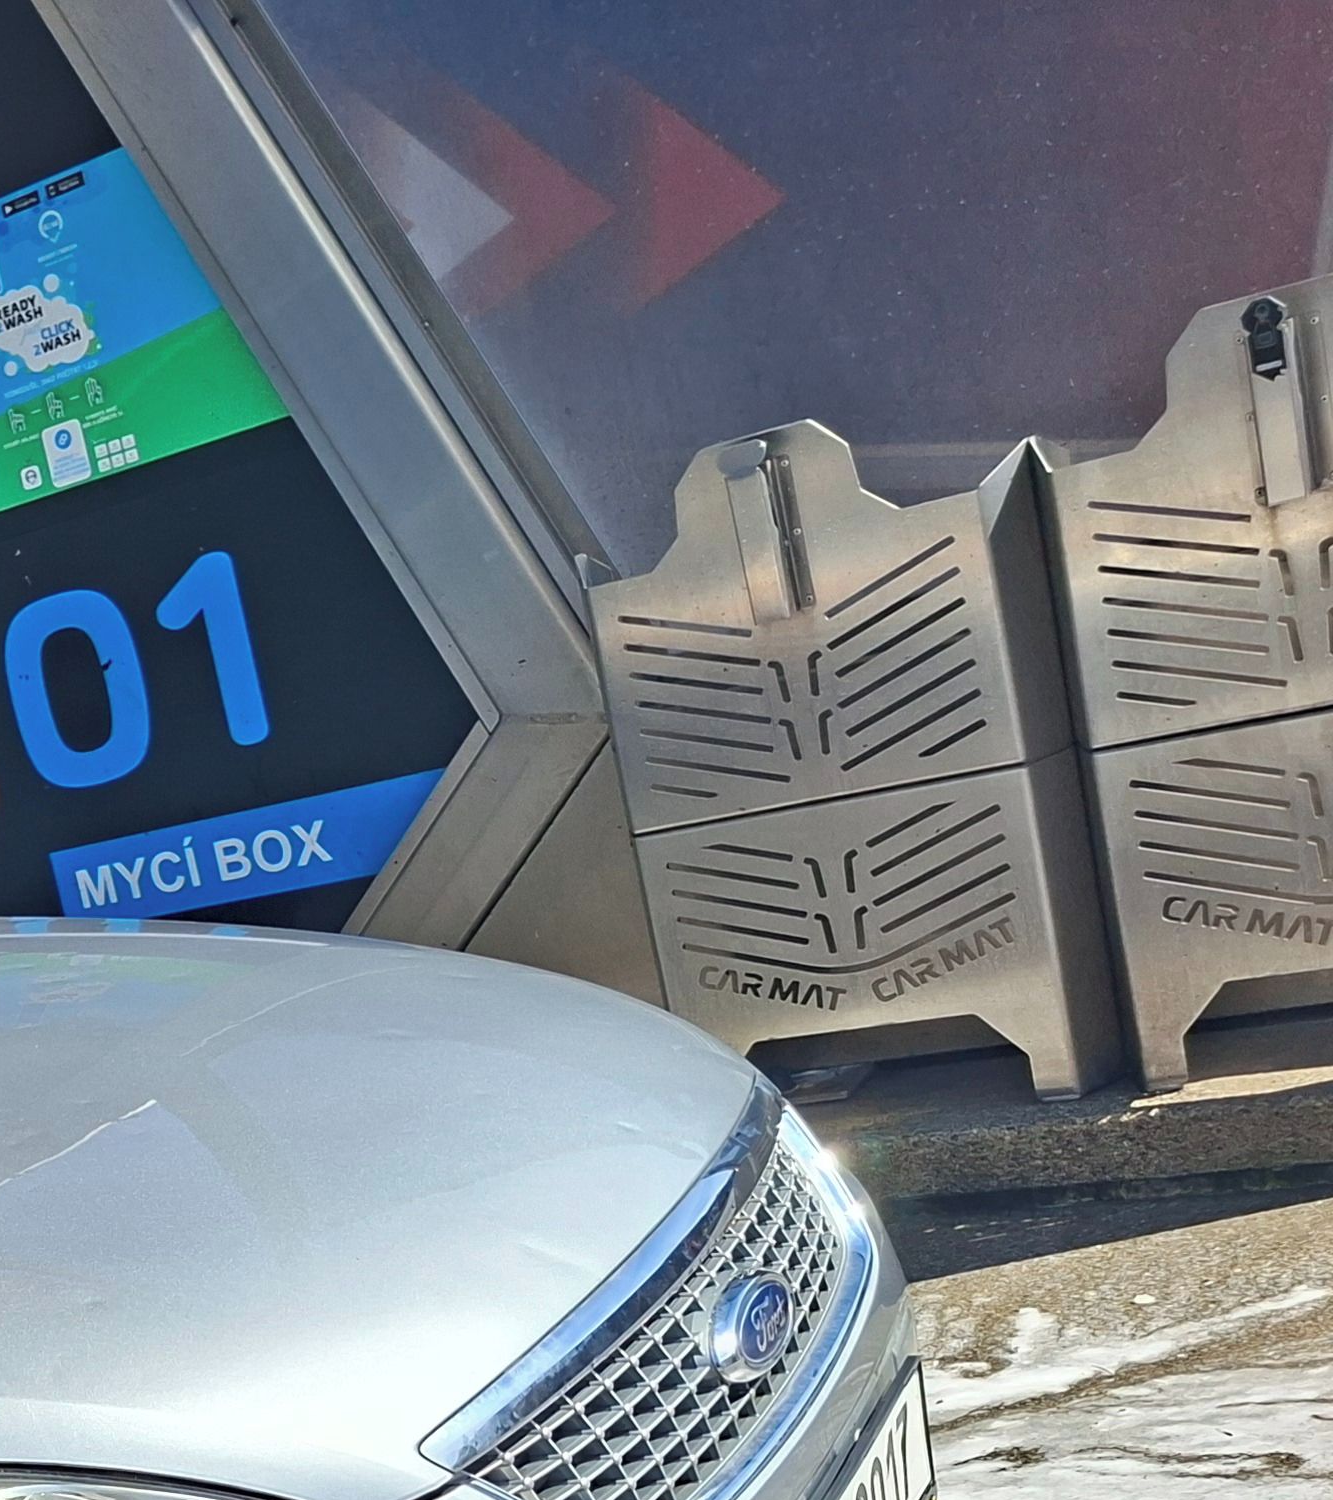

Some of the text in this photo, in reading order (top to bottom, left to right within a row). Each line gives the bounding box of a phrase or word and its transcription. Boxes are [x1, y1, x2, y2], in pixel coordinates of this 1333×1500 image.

[40, 318, 75, 341] CLICK
[4, 550, 270, 788] 01
[74, 820, 334, 909] MYCÍ BOX
[751, 1294, 787, 1353] Ford
